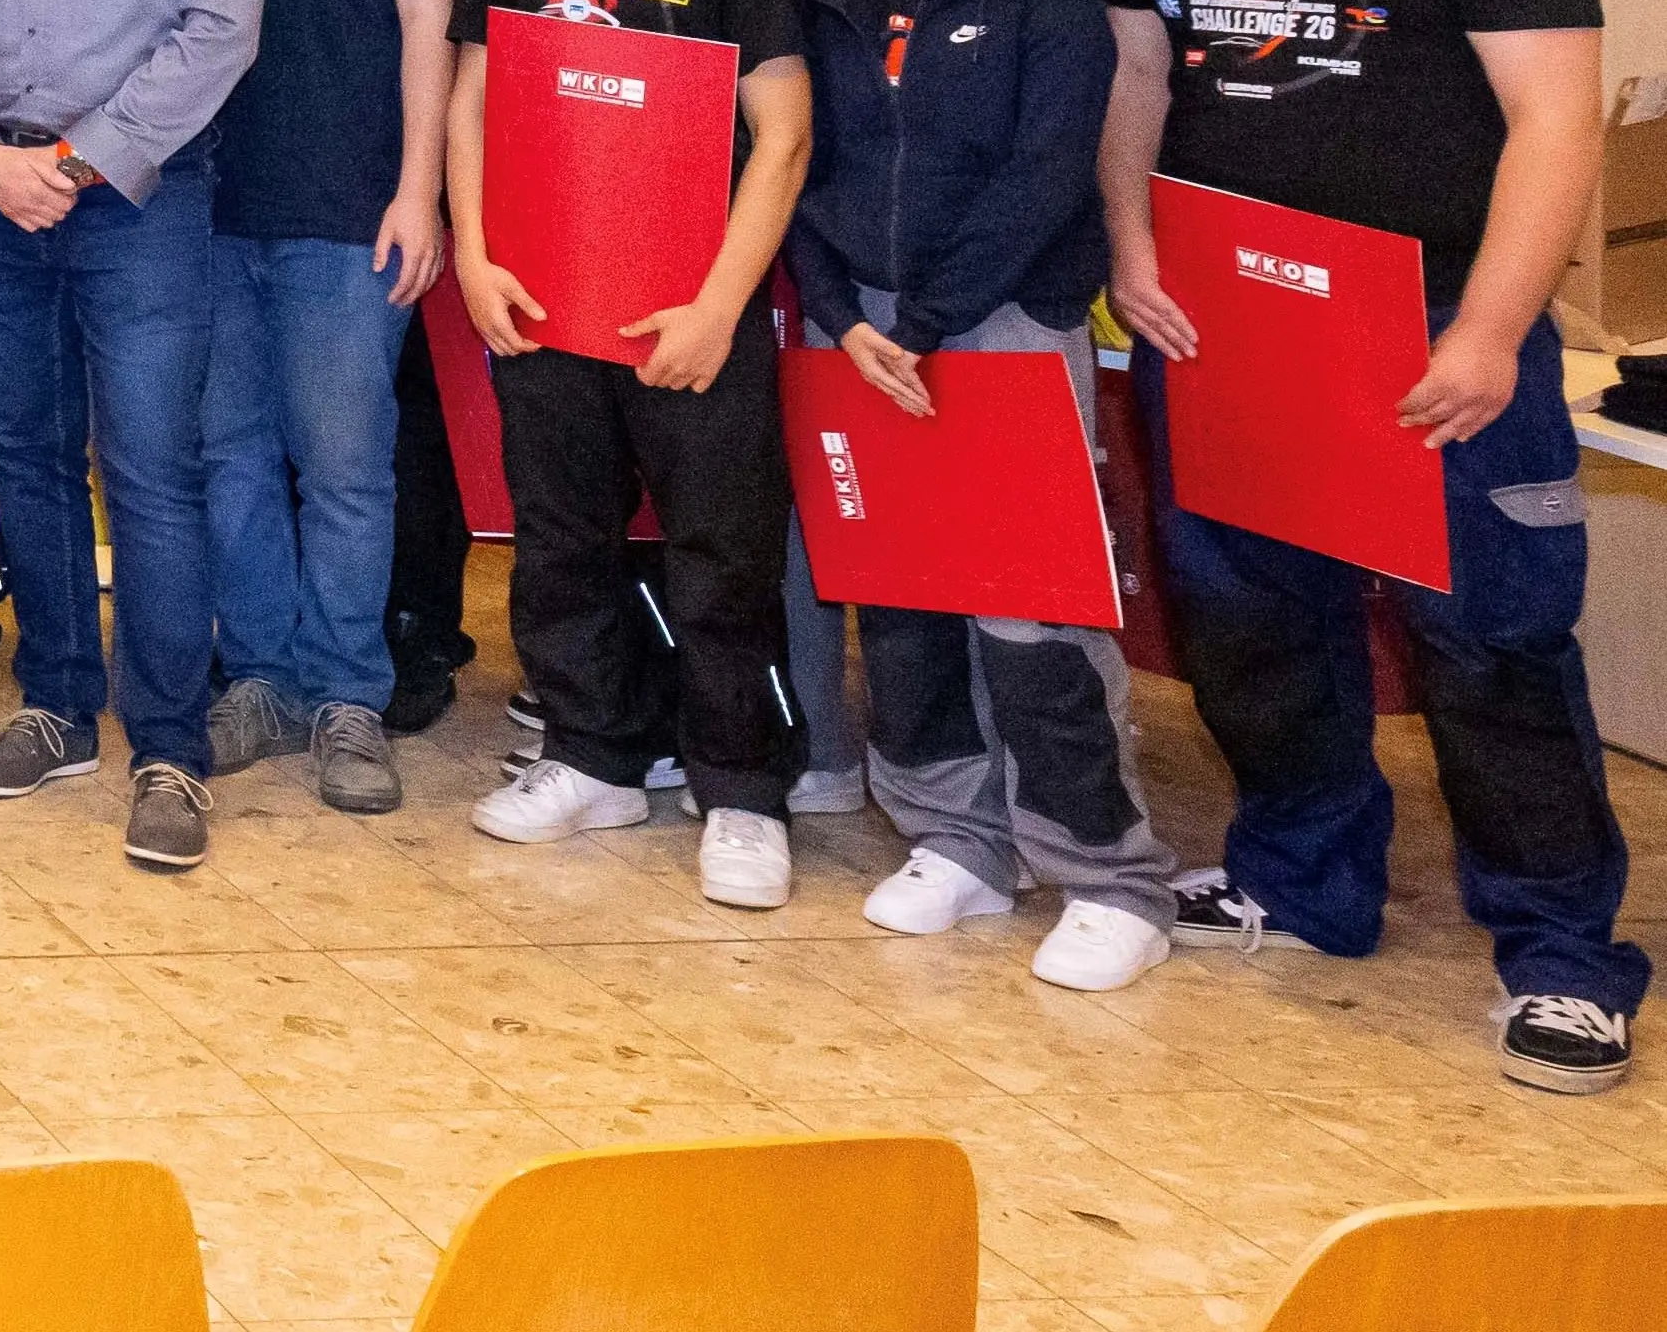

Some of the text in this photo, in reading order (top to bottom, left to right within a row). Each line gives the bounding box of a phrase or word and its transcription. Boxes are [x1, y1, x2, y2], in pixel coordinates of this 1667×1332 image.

[1190, 8, 1337, 41] CHALLENGE 26
[561, 70, 620, 96] WKO
[1238, 248, 1302, 281] WKO
[830, 455, 858, 520] WKO
